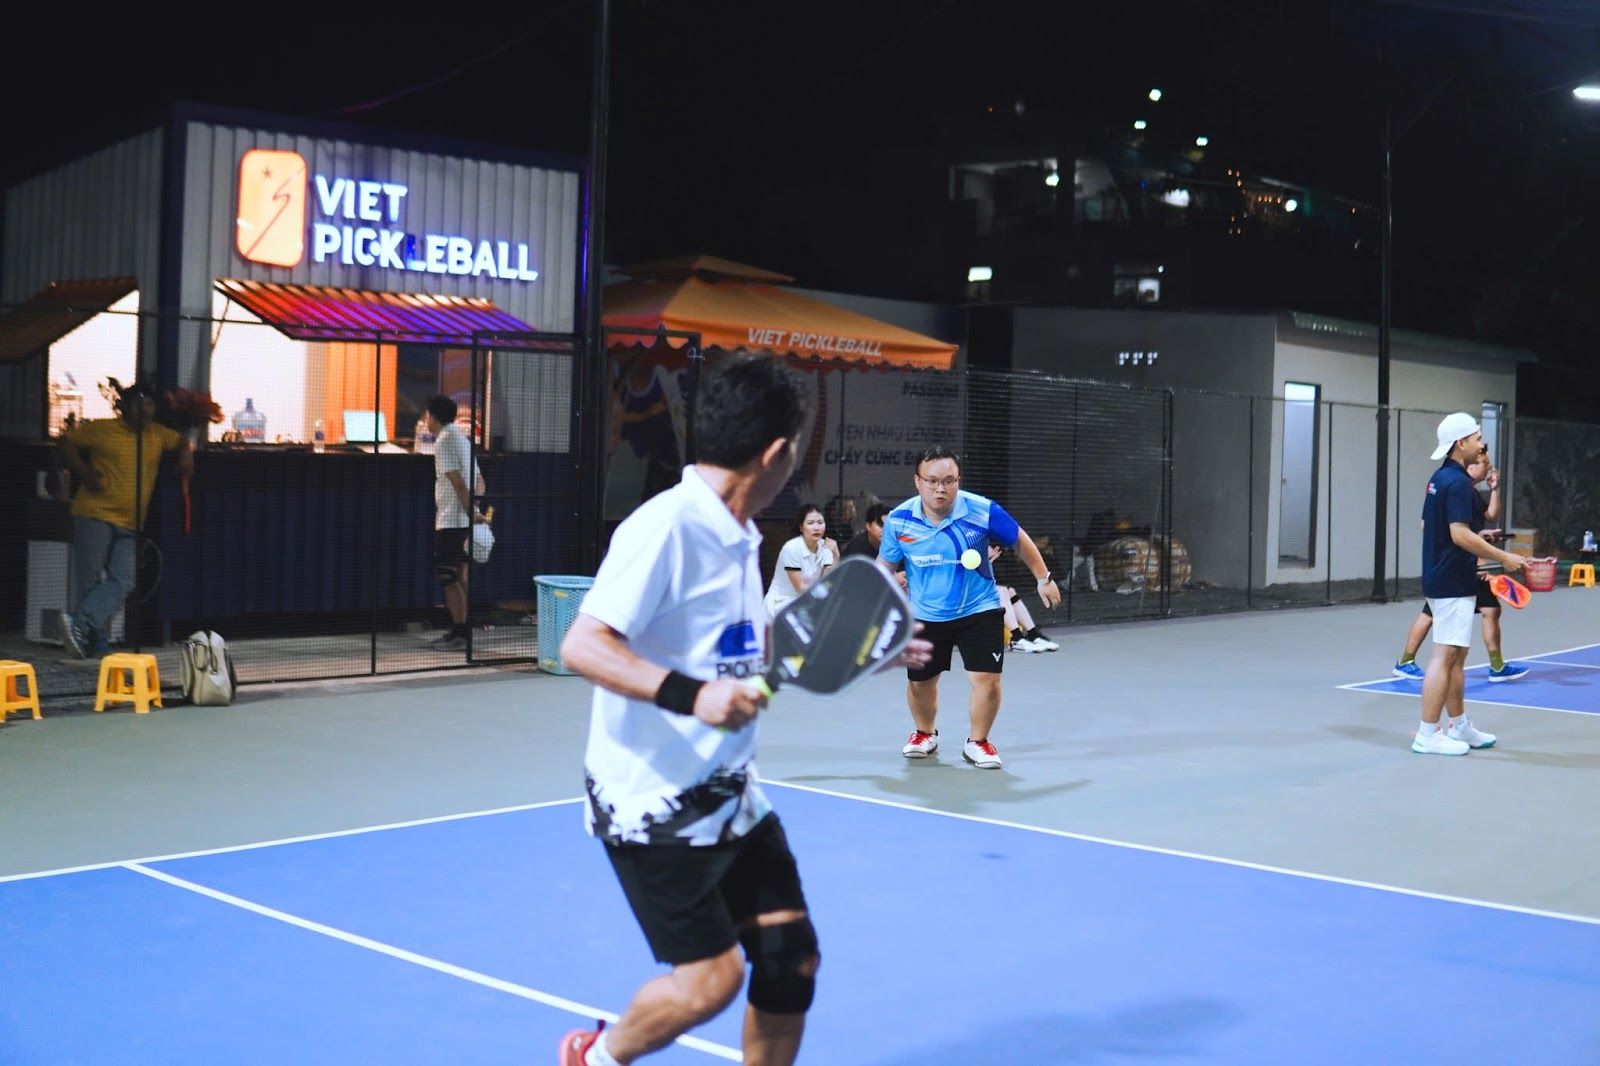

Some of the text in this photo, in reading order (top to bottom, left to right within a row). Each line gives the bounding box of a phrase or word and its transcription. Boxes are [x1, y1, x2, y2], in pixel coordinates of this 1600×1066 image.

[315, 175, 408, 222] VIET
[314, 223, 538, 281] PICKLEBALL
[748, 328, 881, 356] VIET PICKLEBALL
